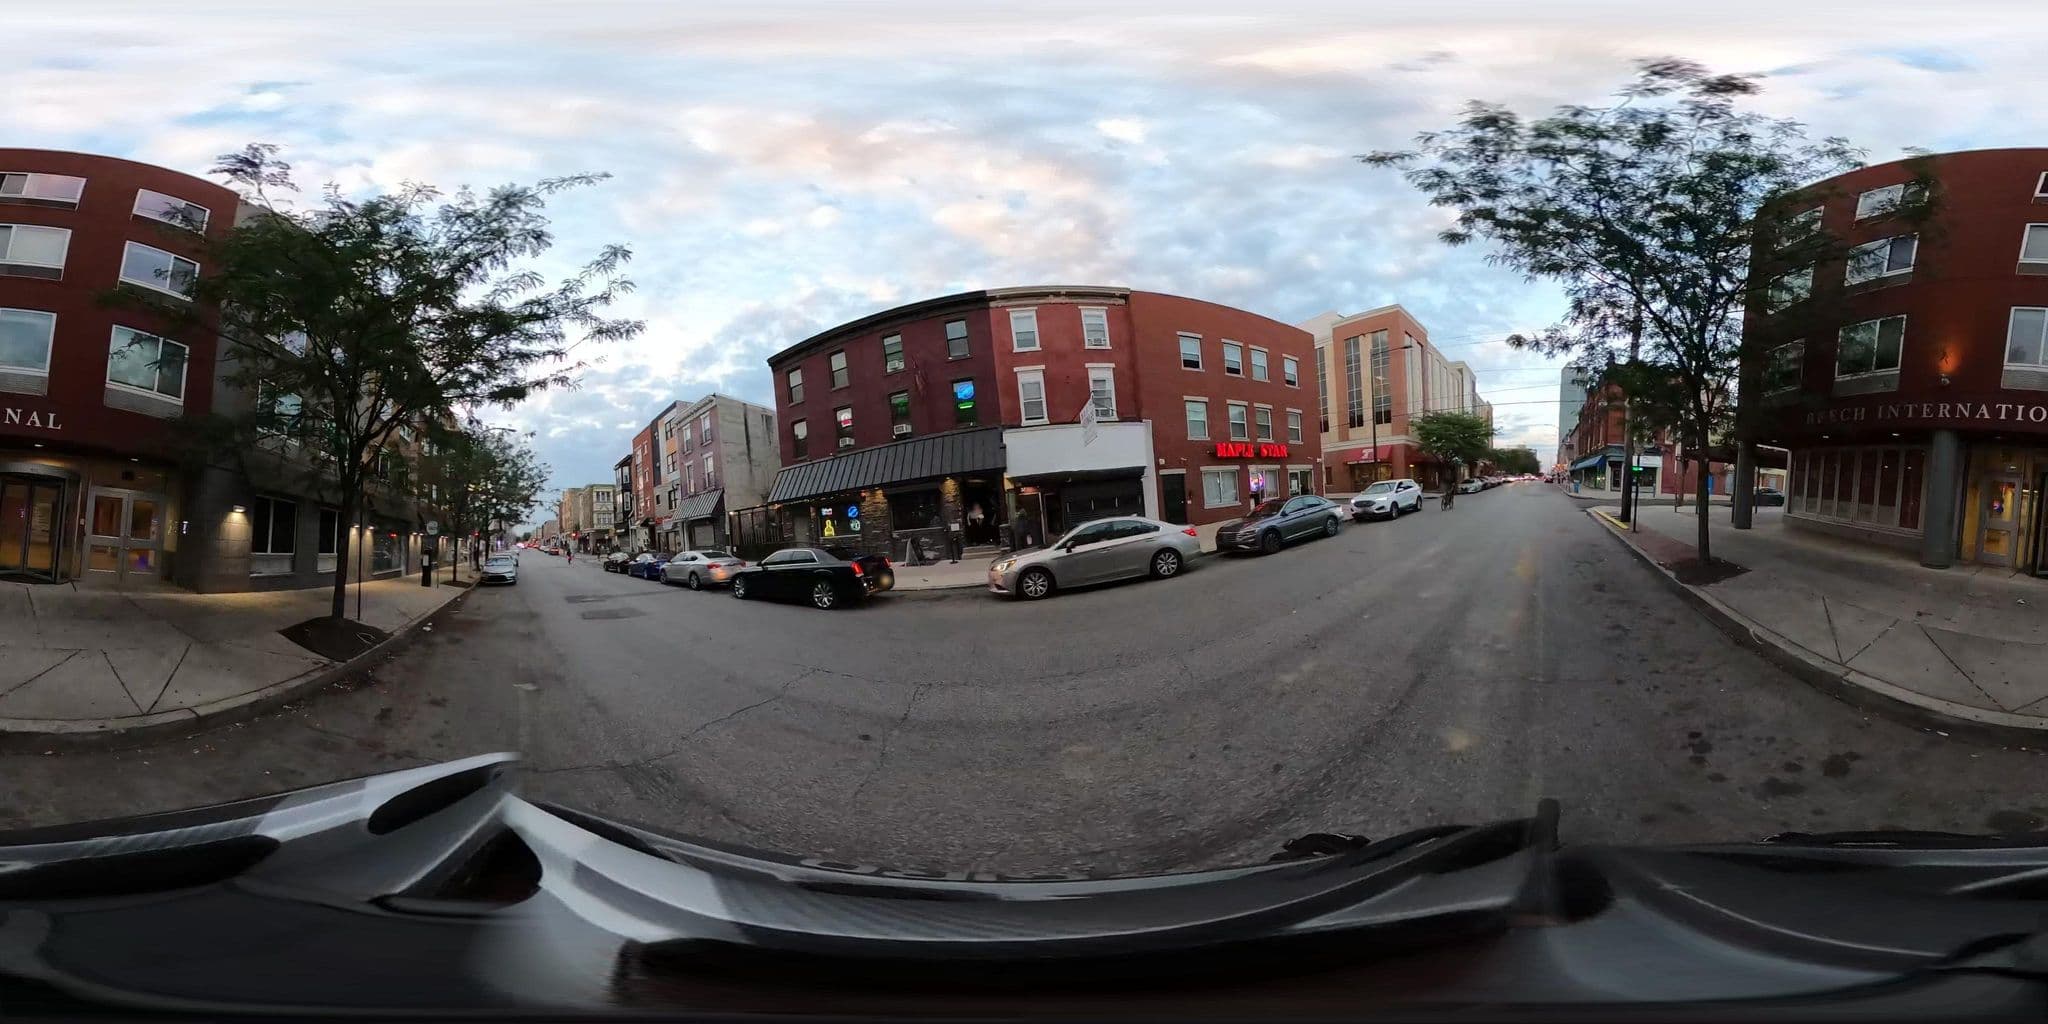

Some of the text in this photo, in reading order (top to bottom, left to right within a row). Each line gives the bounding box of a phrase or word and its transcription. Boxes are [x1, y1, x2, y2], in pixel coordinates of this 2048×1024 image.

[4, 407, 62, 430] NAL
[1877, 402, 2048, 423] INTERNATIO
[1216, 442, 1288, 458] MAPLE STAR
